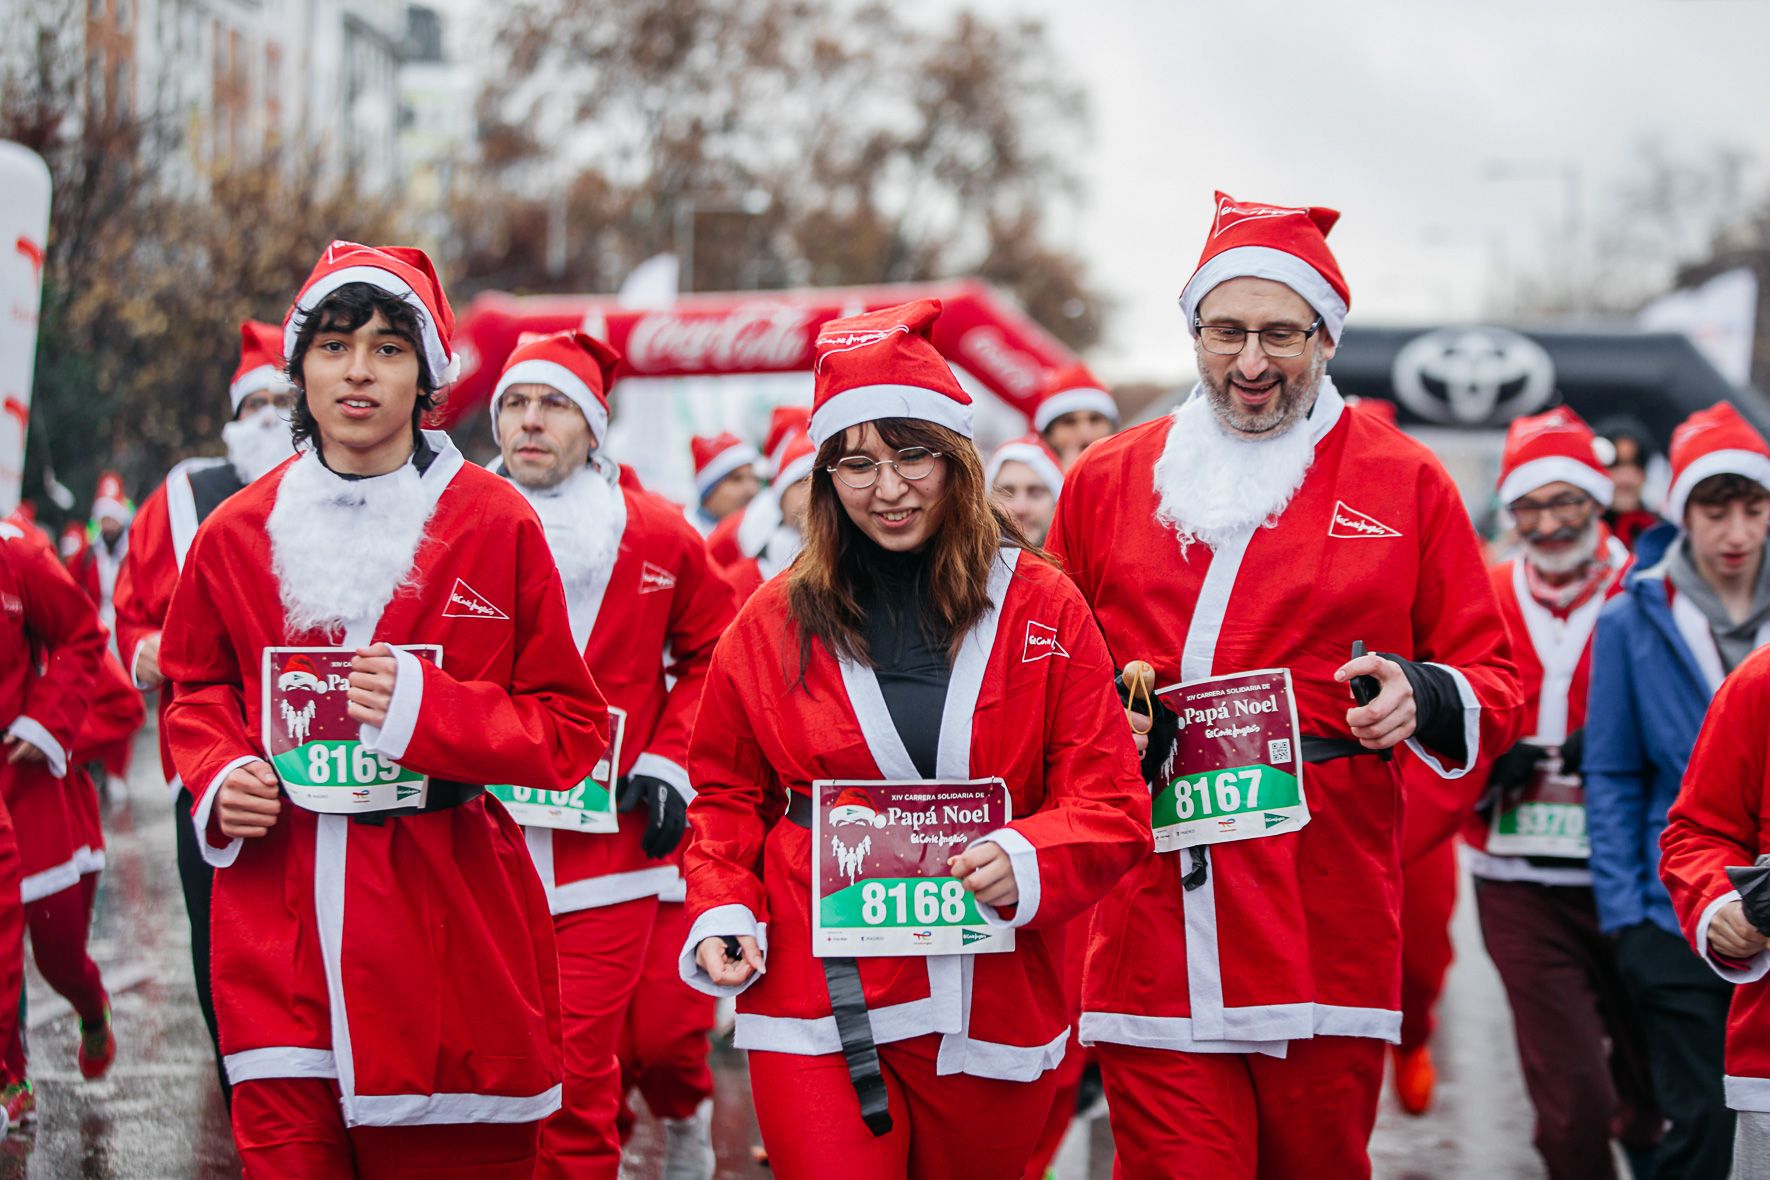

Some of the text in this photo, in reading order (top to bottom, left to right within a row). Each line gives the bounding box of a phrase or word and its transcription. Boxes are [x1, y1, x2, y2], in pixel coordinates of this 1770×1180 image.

[327, 673, 351, 691] Pa
[1196, 690, 1226, 700] CARRERA
[1226, 685, 1261, 695] SOLIDARIA
[1184, 694, 1279, 726] Papá Noel
[904, 793, 936, 801] CARRERA
[937, 792, 974, 800] SOLIDARIA
[1174, 768, 1262, 820] 8167
[887, 803, 990, 830] Papá Noel
[861, 880, 966, 925] 8168
